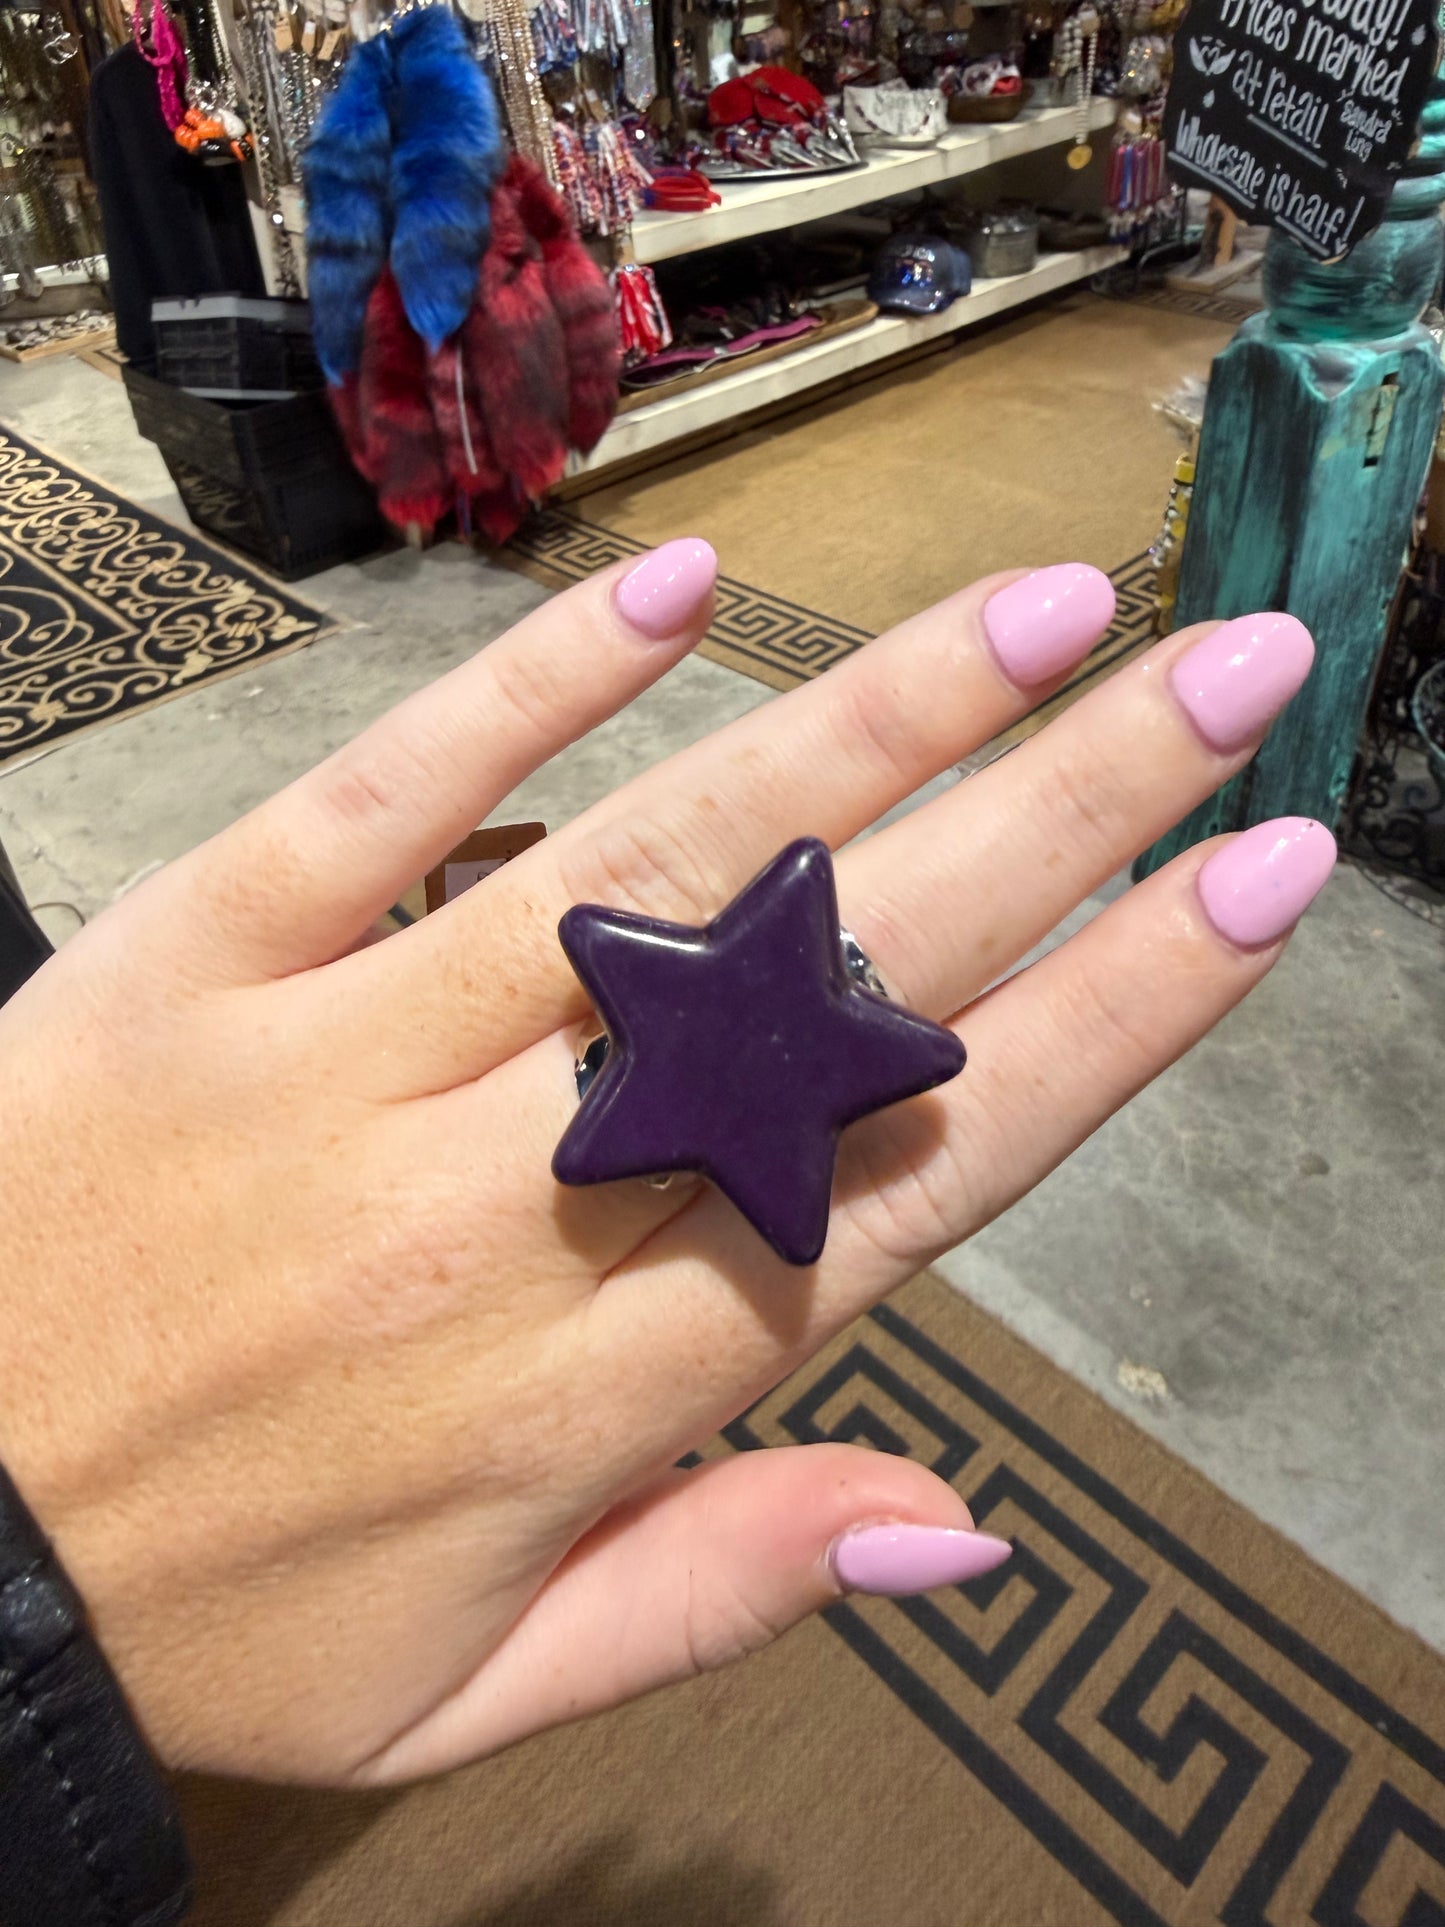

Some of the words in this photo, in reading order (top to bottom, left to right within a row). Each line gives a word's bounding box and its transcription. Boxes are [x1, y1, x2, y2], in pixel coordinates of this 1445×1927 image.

[1232, 50, 1263, 107] at
[1260, 67, 1329, 148] retail
[1295, 15, 1410, 105] marked
[1264, 163, 1291, 213] is
[1284, 179, 1365, 255] half!
